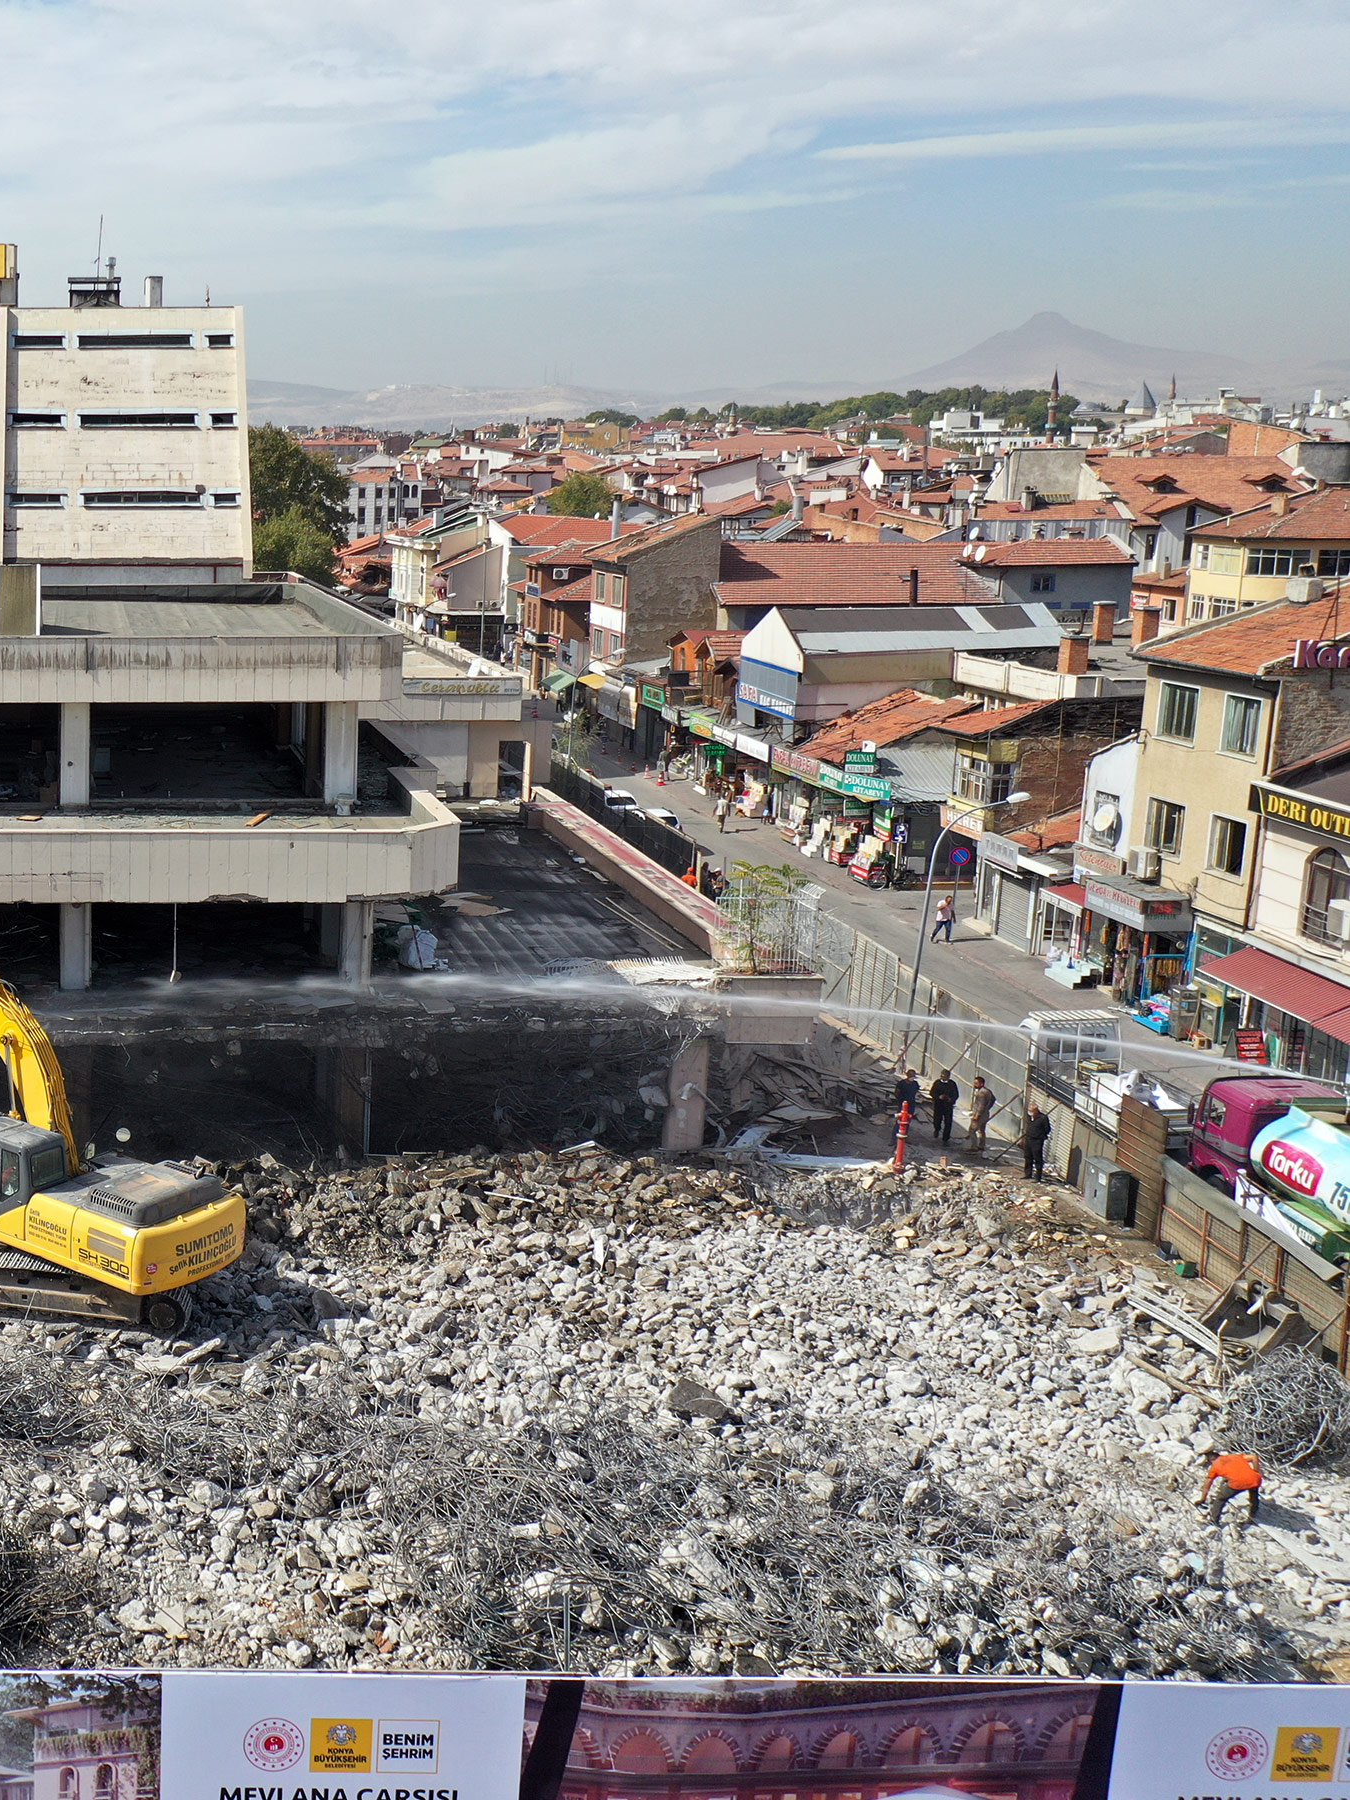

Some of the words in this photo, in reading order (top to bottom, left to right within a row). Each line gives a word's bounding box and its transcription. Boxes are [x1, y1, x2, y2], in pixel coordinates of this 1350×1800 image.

[846, 753, 874, 763] DOLUNAY
[852, 774, 891, 791] DOLUNAY
[1268, 1144, 1315, 1190] Torku
[175, 1222, 234, 1257] SUMITOMO
[78, 1247, 98, 1262] SH
[99, 1255, 130, 1276] 300
[314, 1753, 367, 1764] BÜYÜKŞEHİR
[327, 1747, 354, 1755] KONYA
